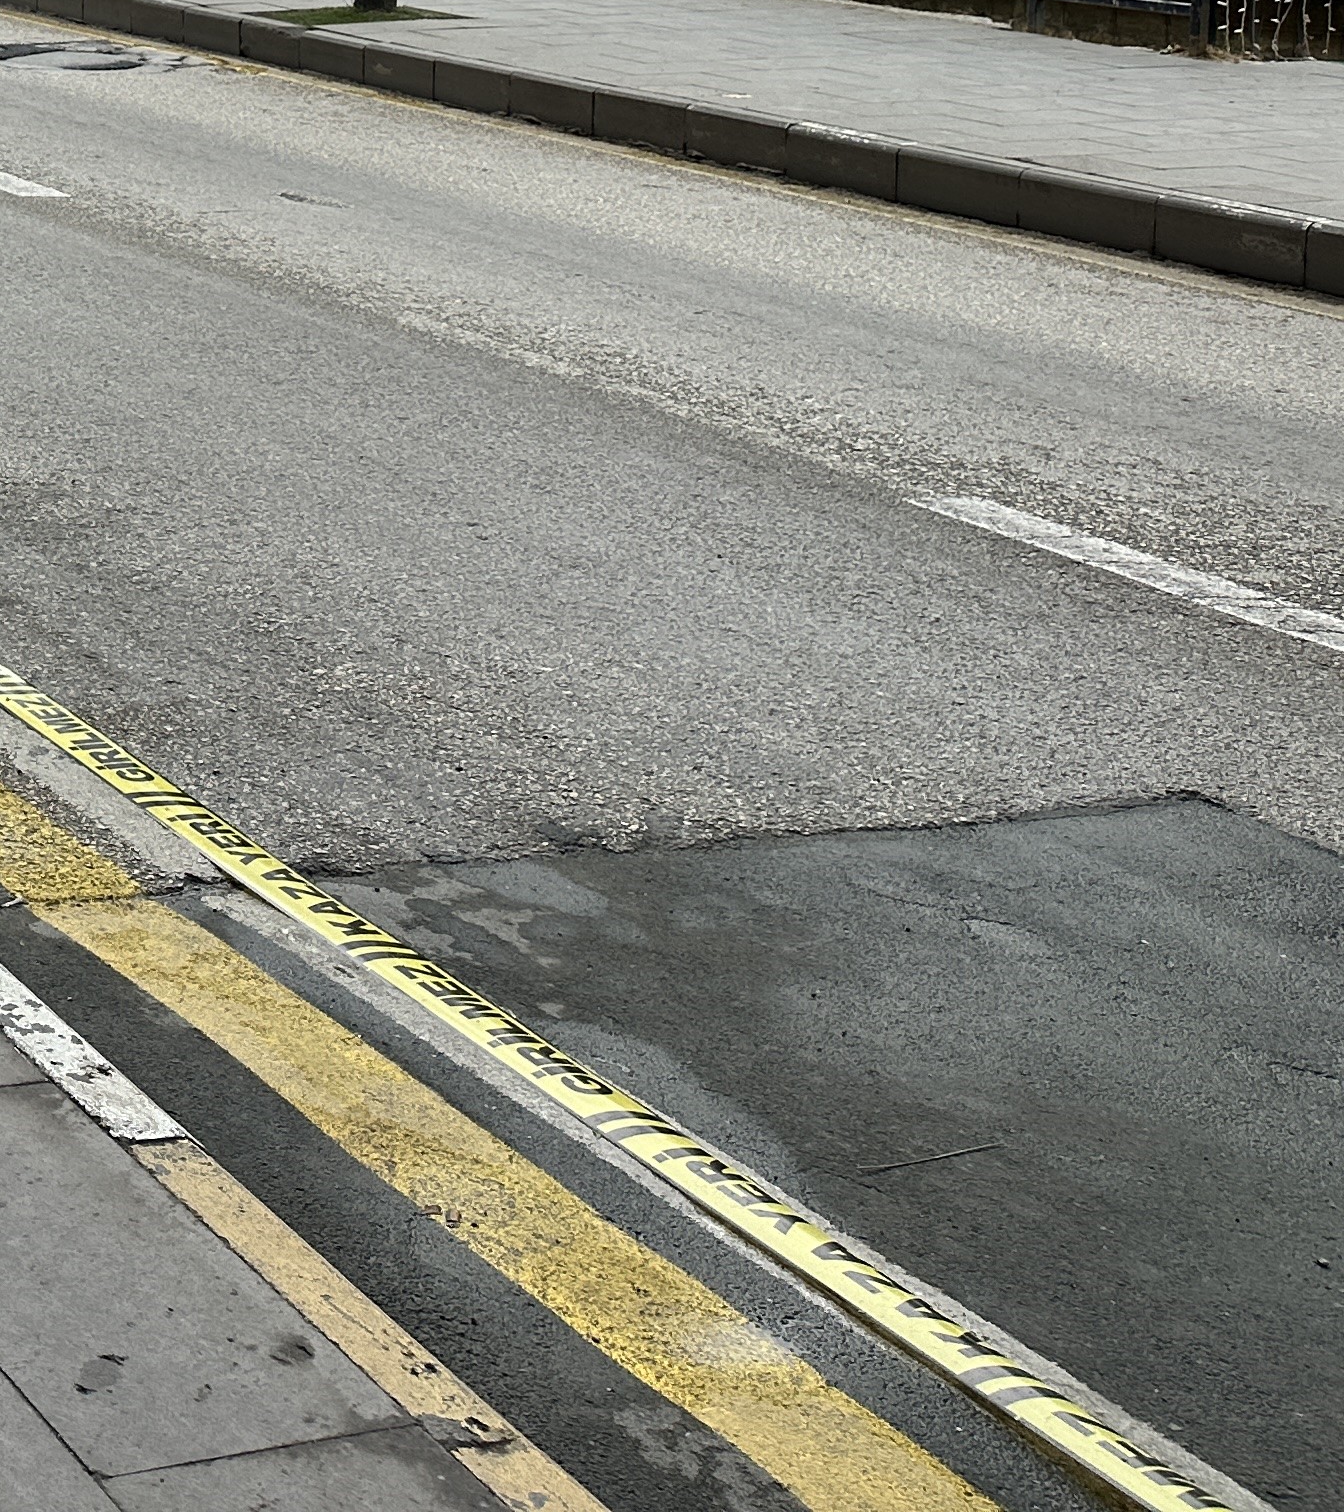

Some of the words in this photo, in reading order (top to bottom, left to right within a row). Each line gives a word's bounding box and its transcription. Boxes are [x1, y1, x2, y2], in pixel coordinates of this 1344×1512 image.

[13, 695, 155, 783] GİRİLMEZ
[167, 813, 269, 867] YERİ
[261, 867, 384, 937] KAZA
[393, 963, 613, 1096] GİRİLMEZ
[652, 1147, 810, 1235] YERİ
[811, 1241, 1006, 1360] KAZA
